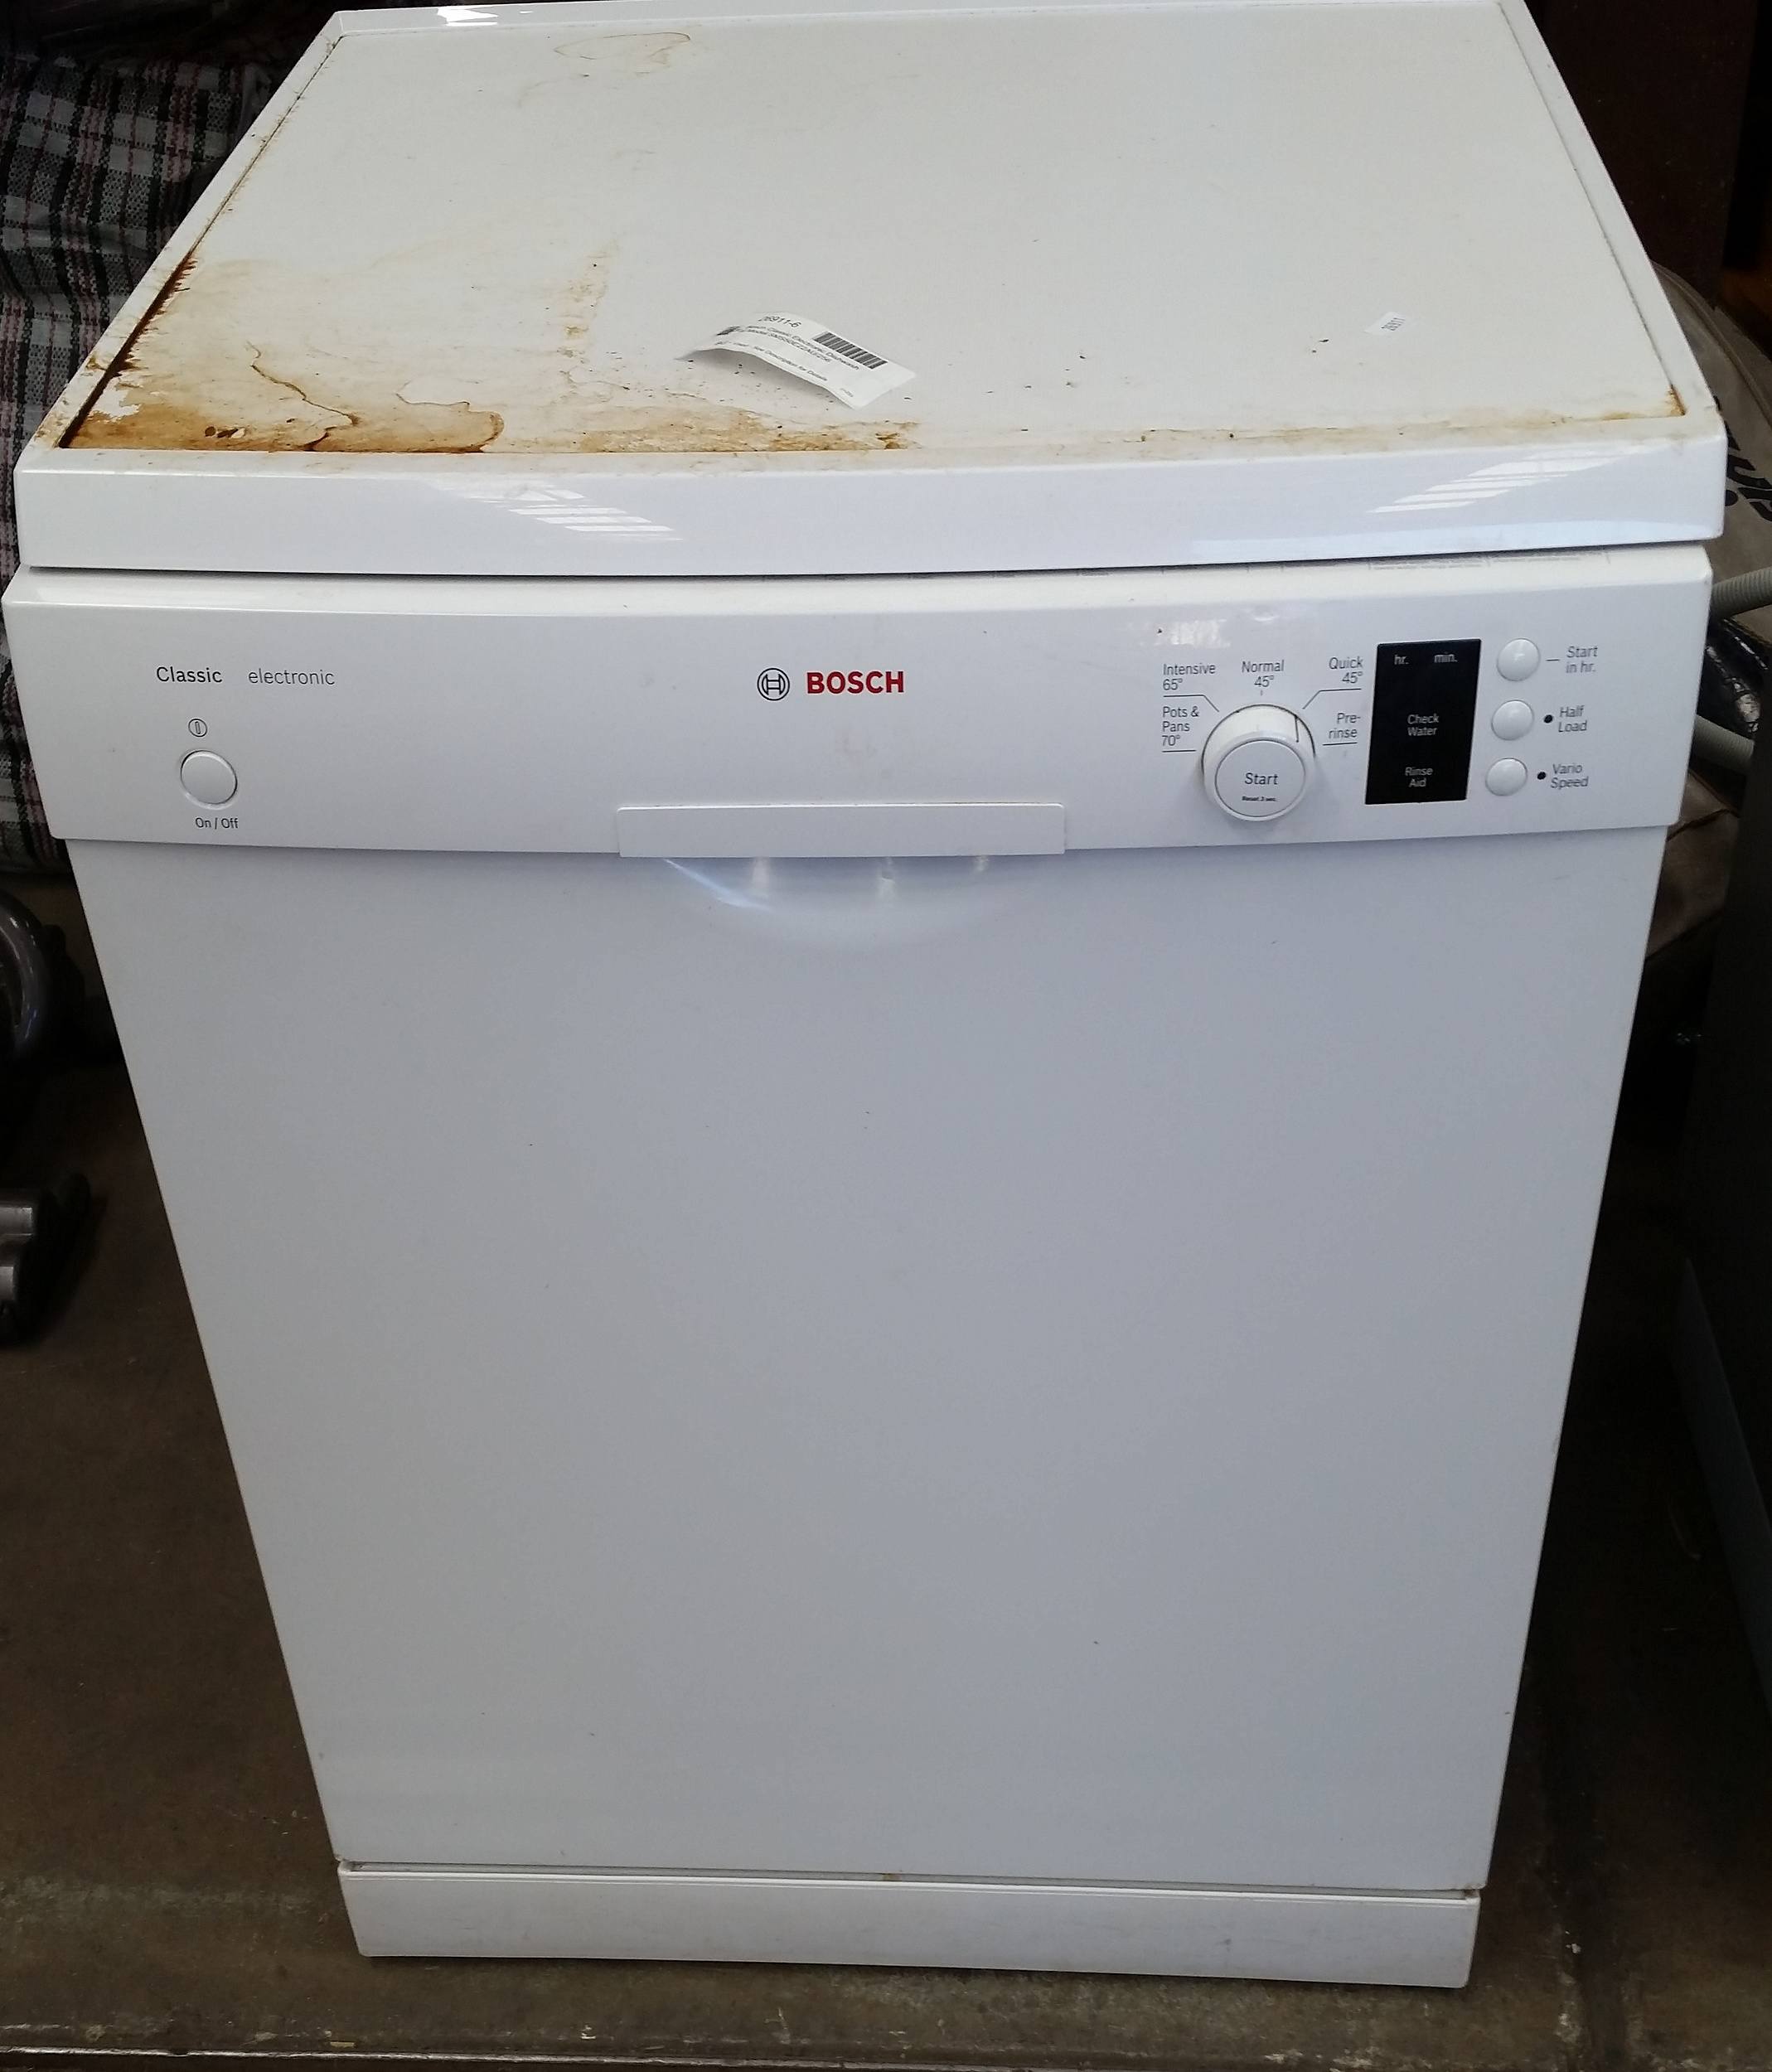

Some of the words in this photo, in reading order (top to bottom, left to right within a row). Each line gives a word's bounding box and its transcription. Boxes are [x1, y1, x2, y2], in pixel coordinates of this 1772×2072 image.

[1394, 653, 1410, 665] hr.
[1434, 651, 1457, 663] min.
[1566, 646, 1599, 658] Start
[1242, 660, 1285, 673] Normal
[1329, 656, 1363, 670] Quick
[1566, 662, 1578, 673] in
[1581, 661, 1596, 673] hr.
[156, 666, 223, 684] Classic
[248, 668, 336, 685] electronic
[1163, 663, 1216, 676] Intensive
[806, 670, 905, 695] BOSCH
[1162, 706, 1188, 718] Pots
[1191, 706, 1200, 718] &
[1560, 704, 1585, 717] Half
[1337, 712, 1361, 724] Pre-
[1406, 714, 1440, 724] Check
[1162, 720, 1190, 732] Pans
[1407, 726, 1438, 737] Water
[1558, 721, 1588, 733] Load
[1329, 727, 1358, 738] rinse
[1405, 766, 1434, 777] Rinse
[1552, 763, 1583, 775] Vario
[1244, 772, 1279, 786] Start
[1408, 777, 1427, 788] Aid
[1550, 776, 1589, 790] Speed
[195, 817, 211, 830] On
[214, 817, 219, 830] /
[220, 818, 239, 830] Off
